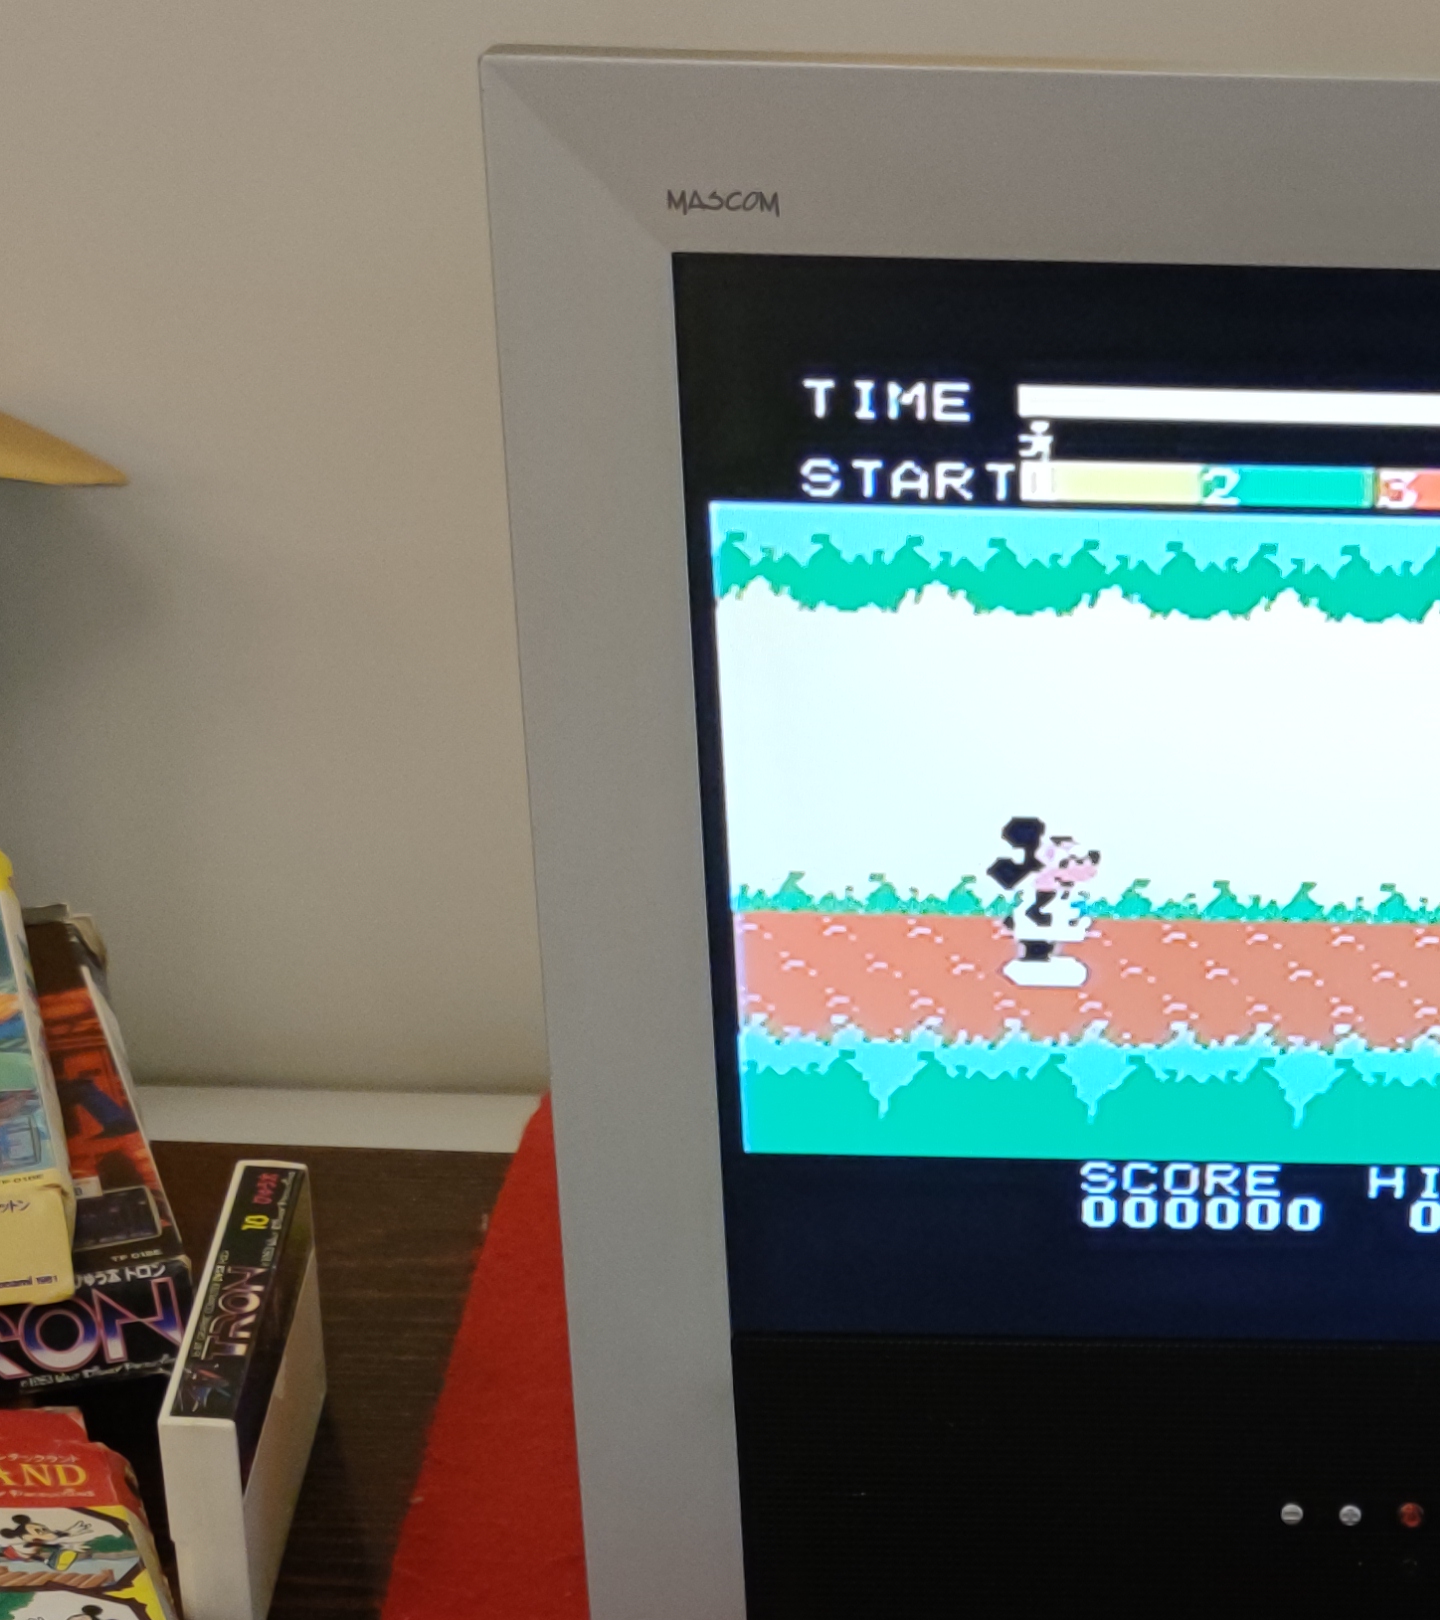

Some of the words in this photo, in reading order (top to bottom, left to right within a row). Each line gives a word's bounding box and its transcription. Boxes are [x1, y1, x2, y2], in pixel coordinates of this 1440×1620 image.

[667, 189, 780, 217] MASCOM
[802, 379, 973, 422] TIME
[800, 458, 1016, 501] START
[1201, 467, 1243, 506] 2
[1377, 470, 1419, 510] 3
[1079, 1161, 1282, 1198] SCORE
[1081, 1195, 1324, 1232] 000000
[124, 1263, 167, 1281] トロン
[201, 1266, 265, 1360] TRON
